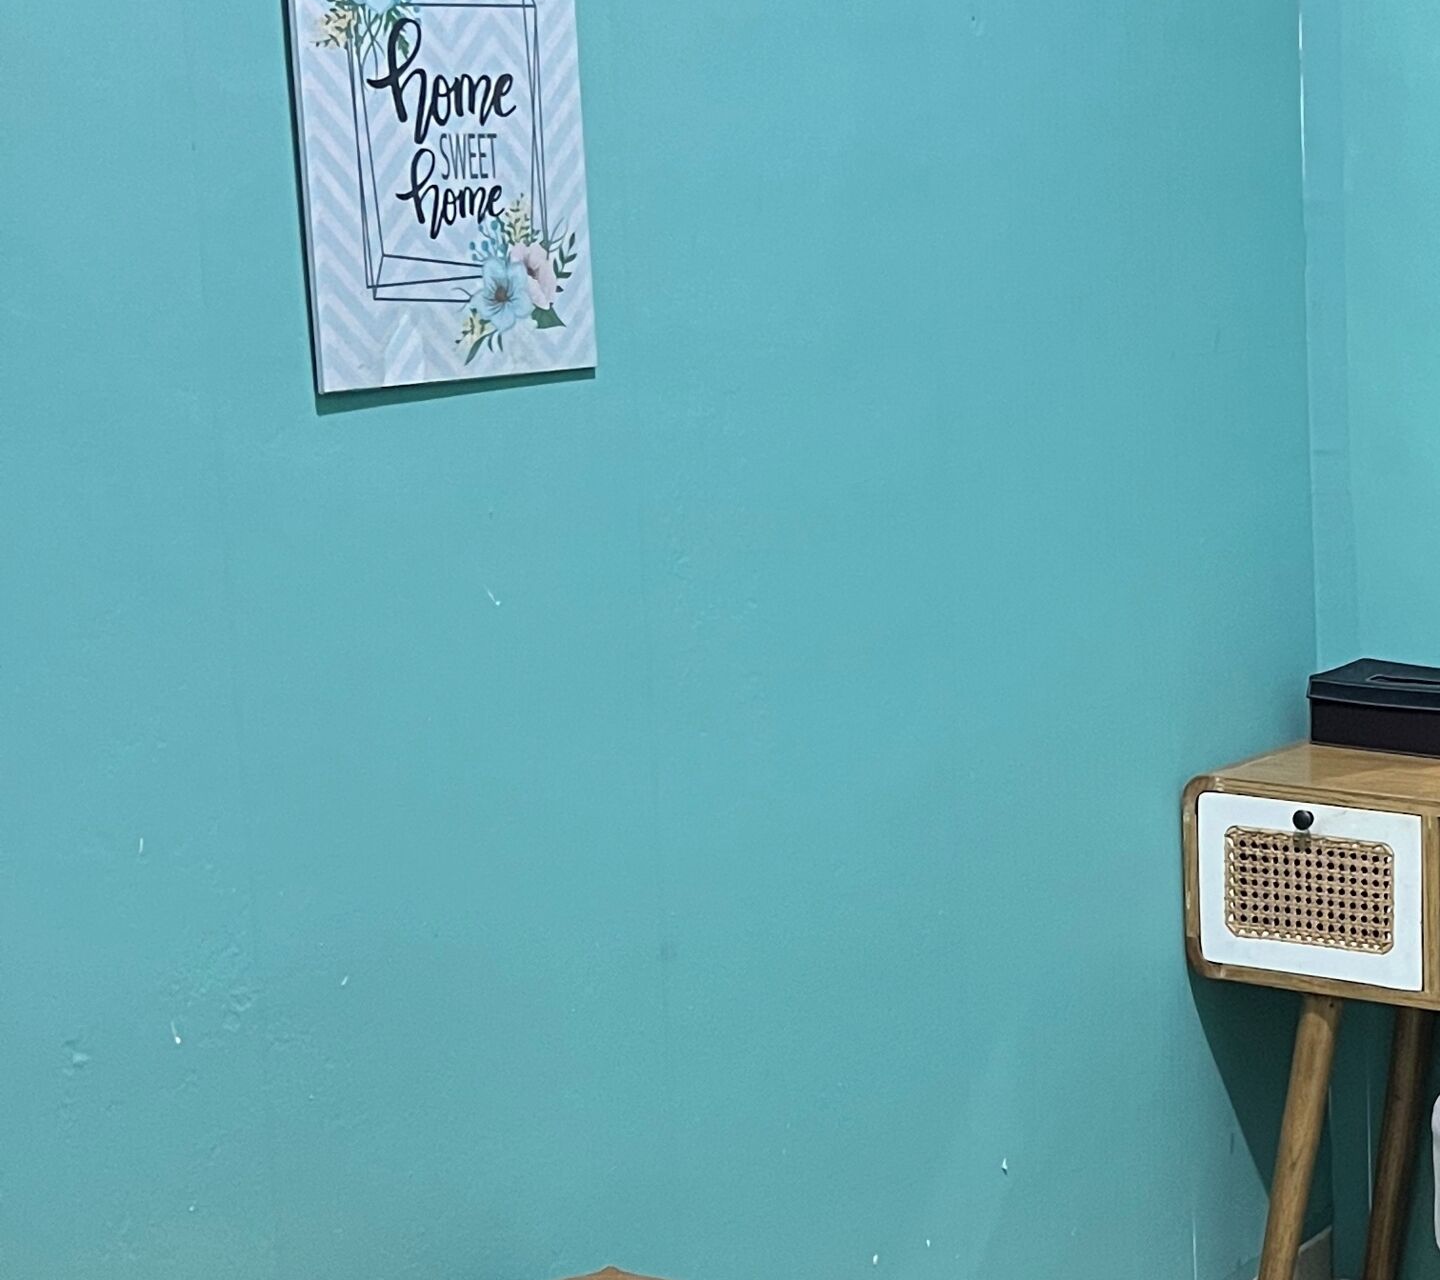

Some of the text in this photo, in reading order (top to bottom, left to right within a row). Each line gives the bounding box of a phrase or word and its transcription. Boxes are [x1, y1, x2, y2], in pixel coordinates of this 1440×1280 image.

[367, 18, 518, 145] home
[395, 148, 507, 240] home
[439, 132, 498, 182] SWEET
